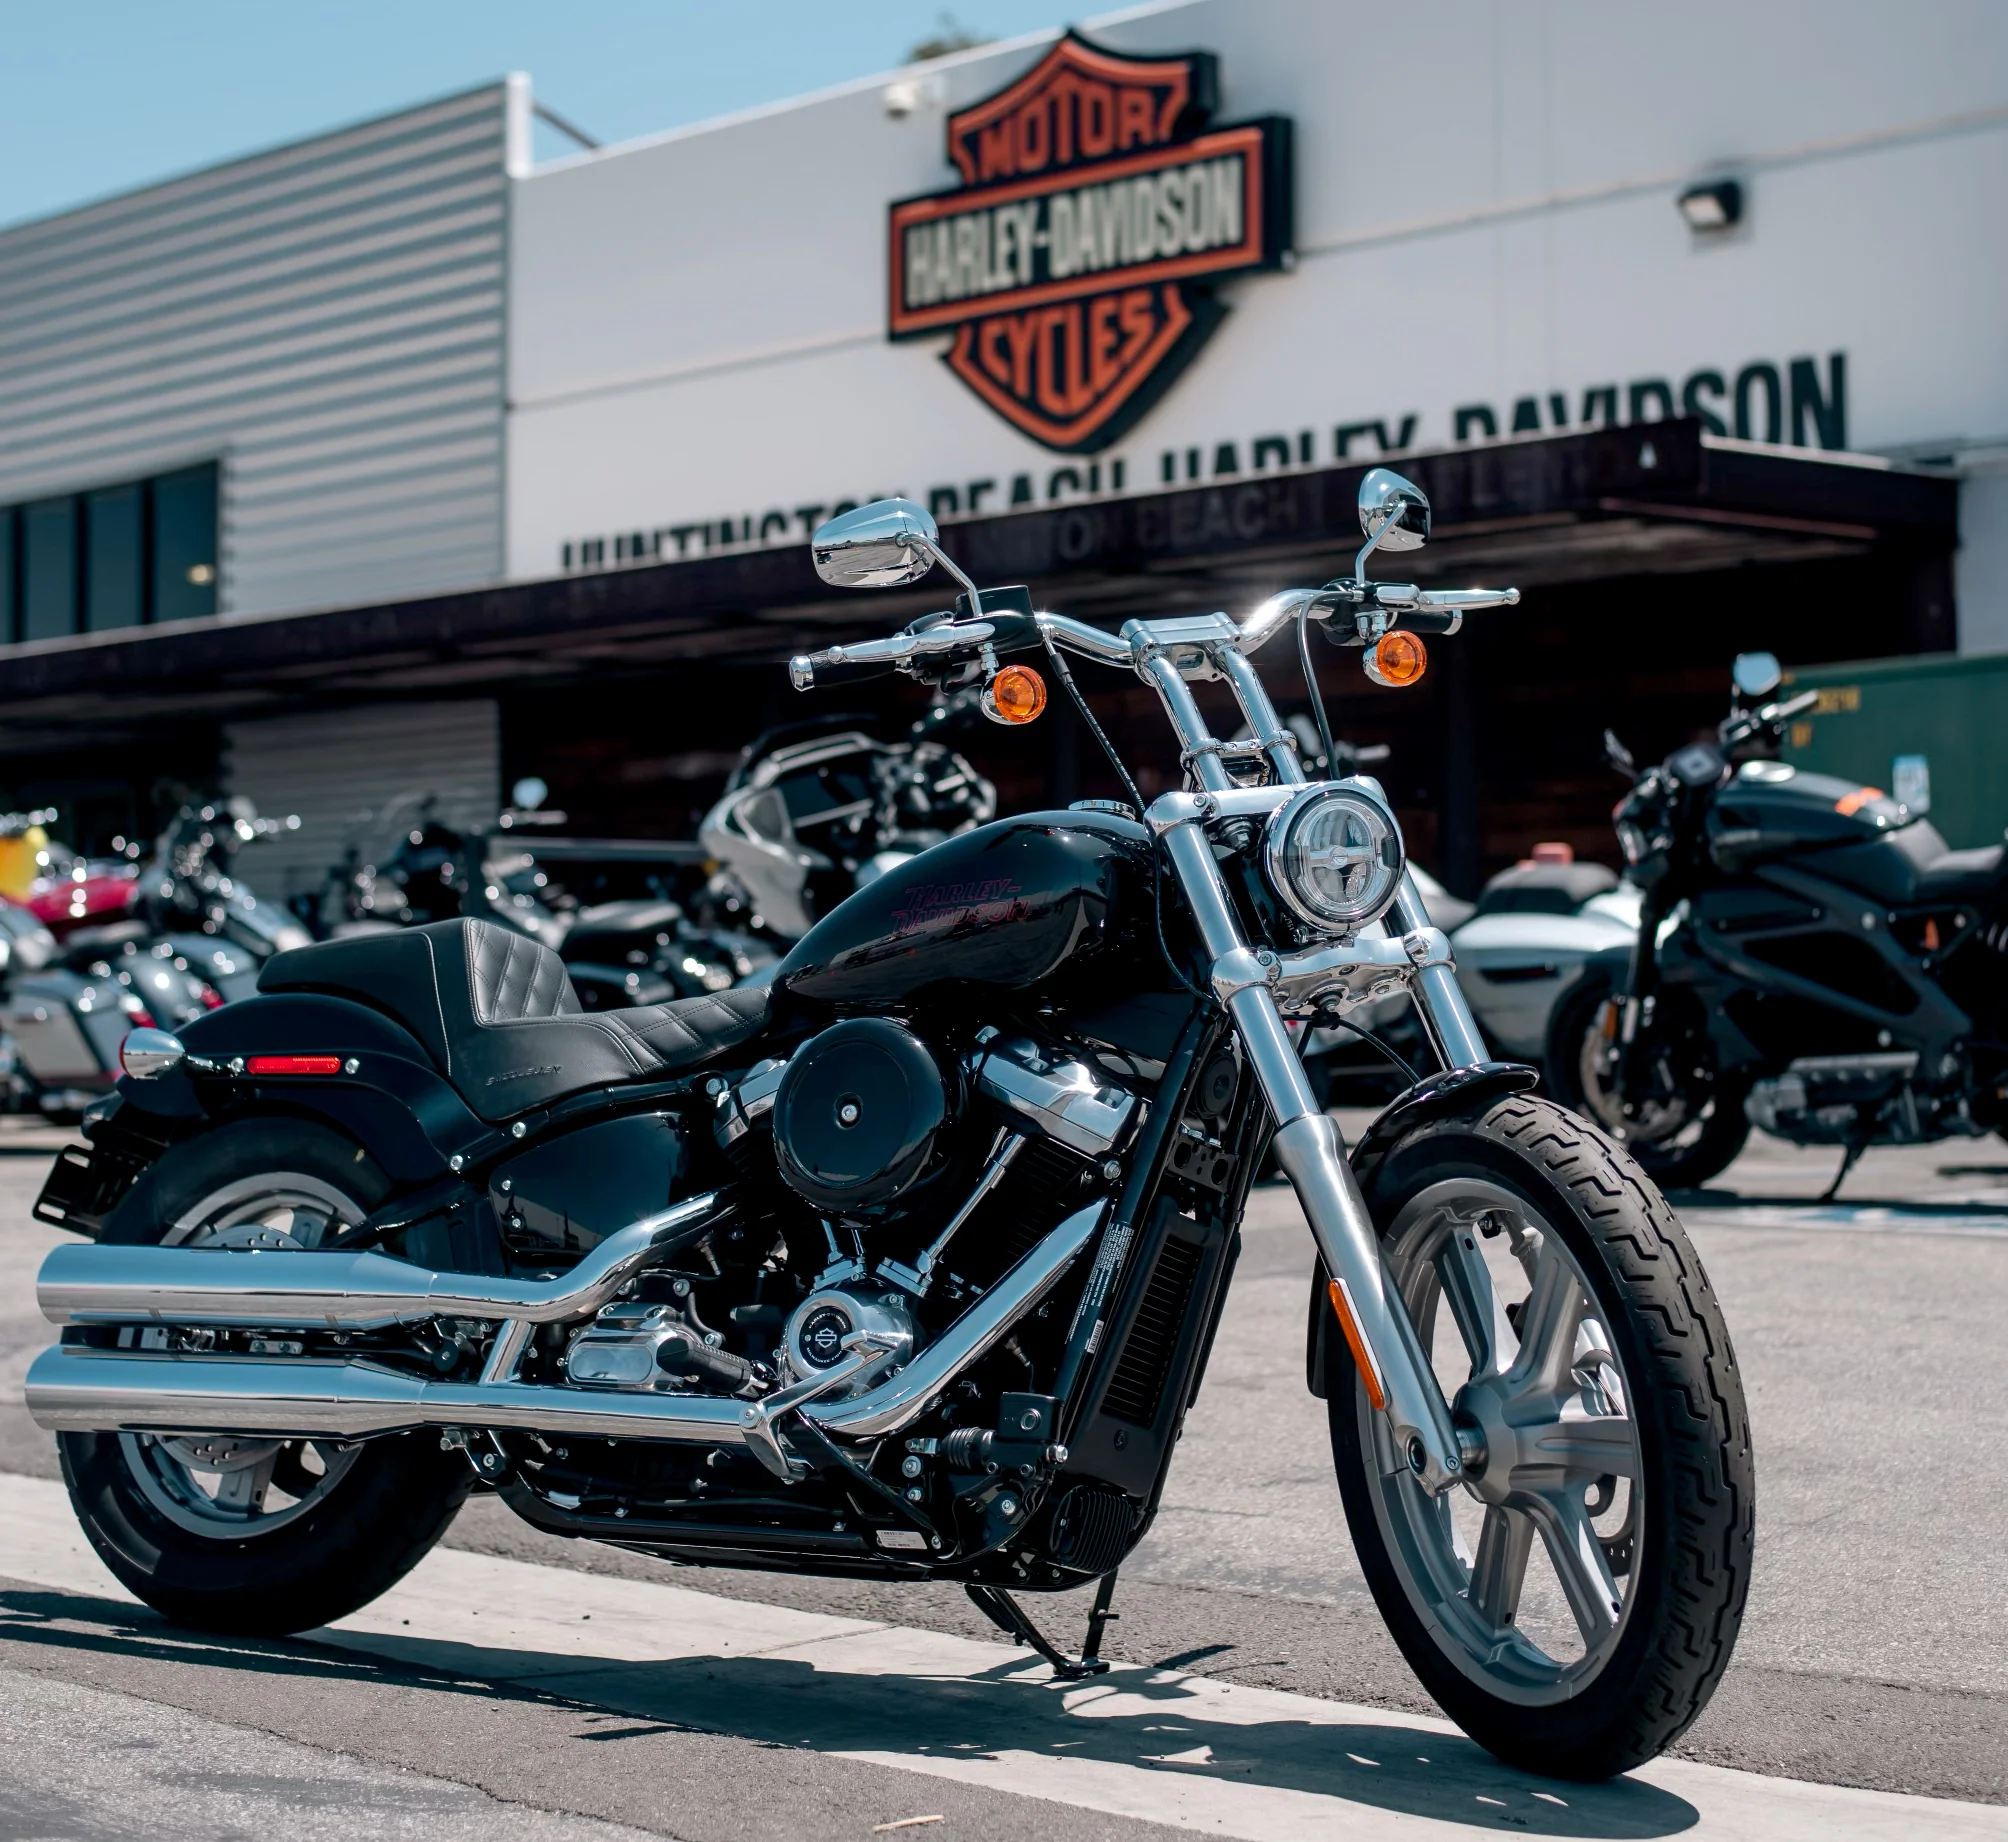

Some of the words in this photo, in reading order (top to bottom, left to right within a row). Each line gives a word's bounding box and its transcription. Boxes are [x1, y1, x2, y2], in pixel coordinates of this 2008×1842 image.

[976, 71, 1156, 181] MOTOR
[905, 156, 1243, 307] HARLEY-DAVIDSON
[978, 288, 1155, 415] CYCLES
[891, 900, 1029, 933] DAVIDSON
[806, 1347, 843, 1363] MILWAUKEE-EIGH
